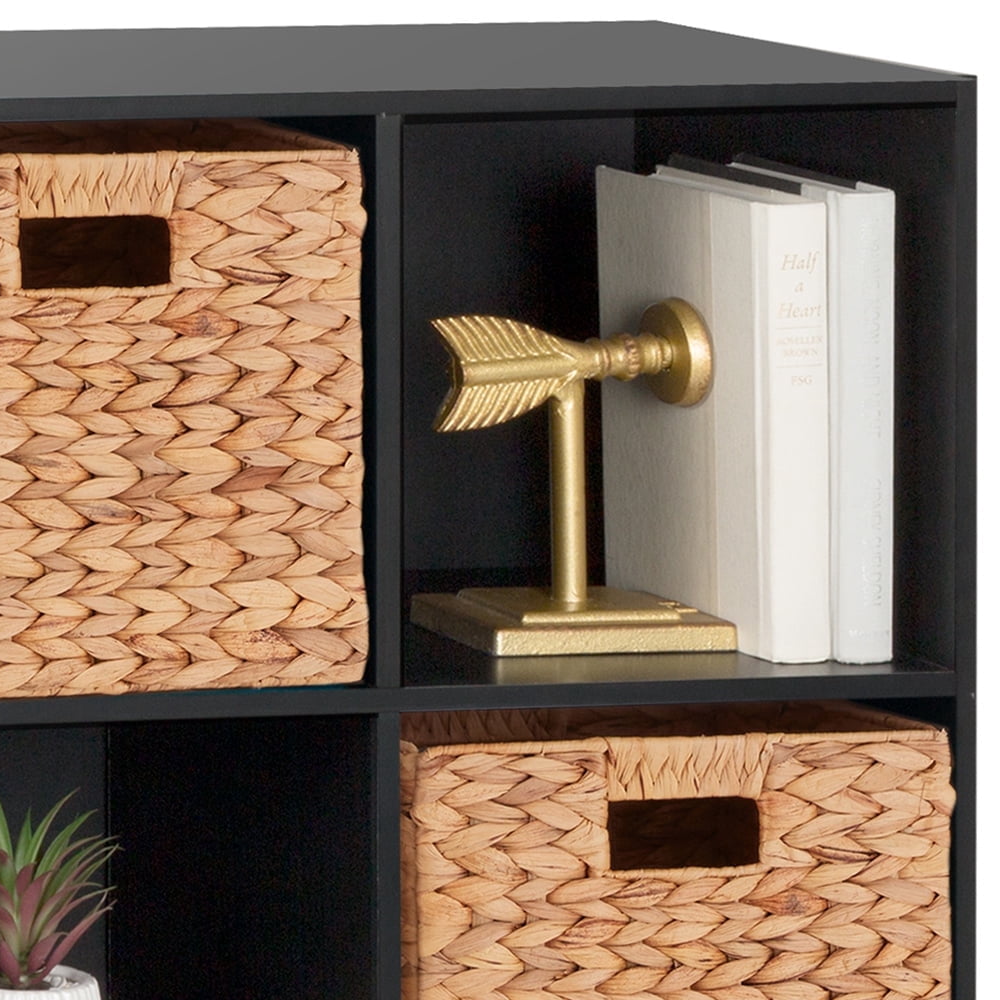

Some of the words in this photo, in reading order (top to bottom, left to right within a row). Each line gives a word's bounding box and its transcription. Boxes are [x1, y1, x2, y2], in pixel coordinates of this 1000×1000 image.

[781, 250, 819, 274] Half
[793, 282, 804, 292] a
[777, 302, 822, 319] Heart
